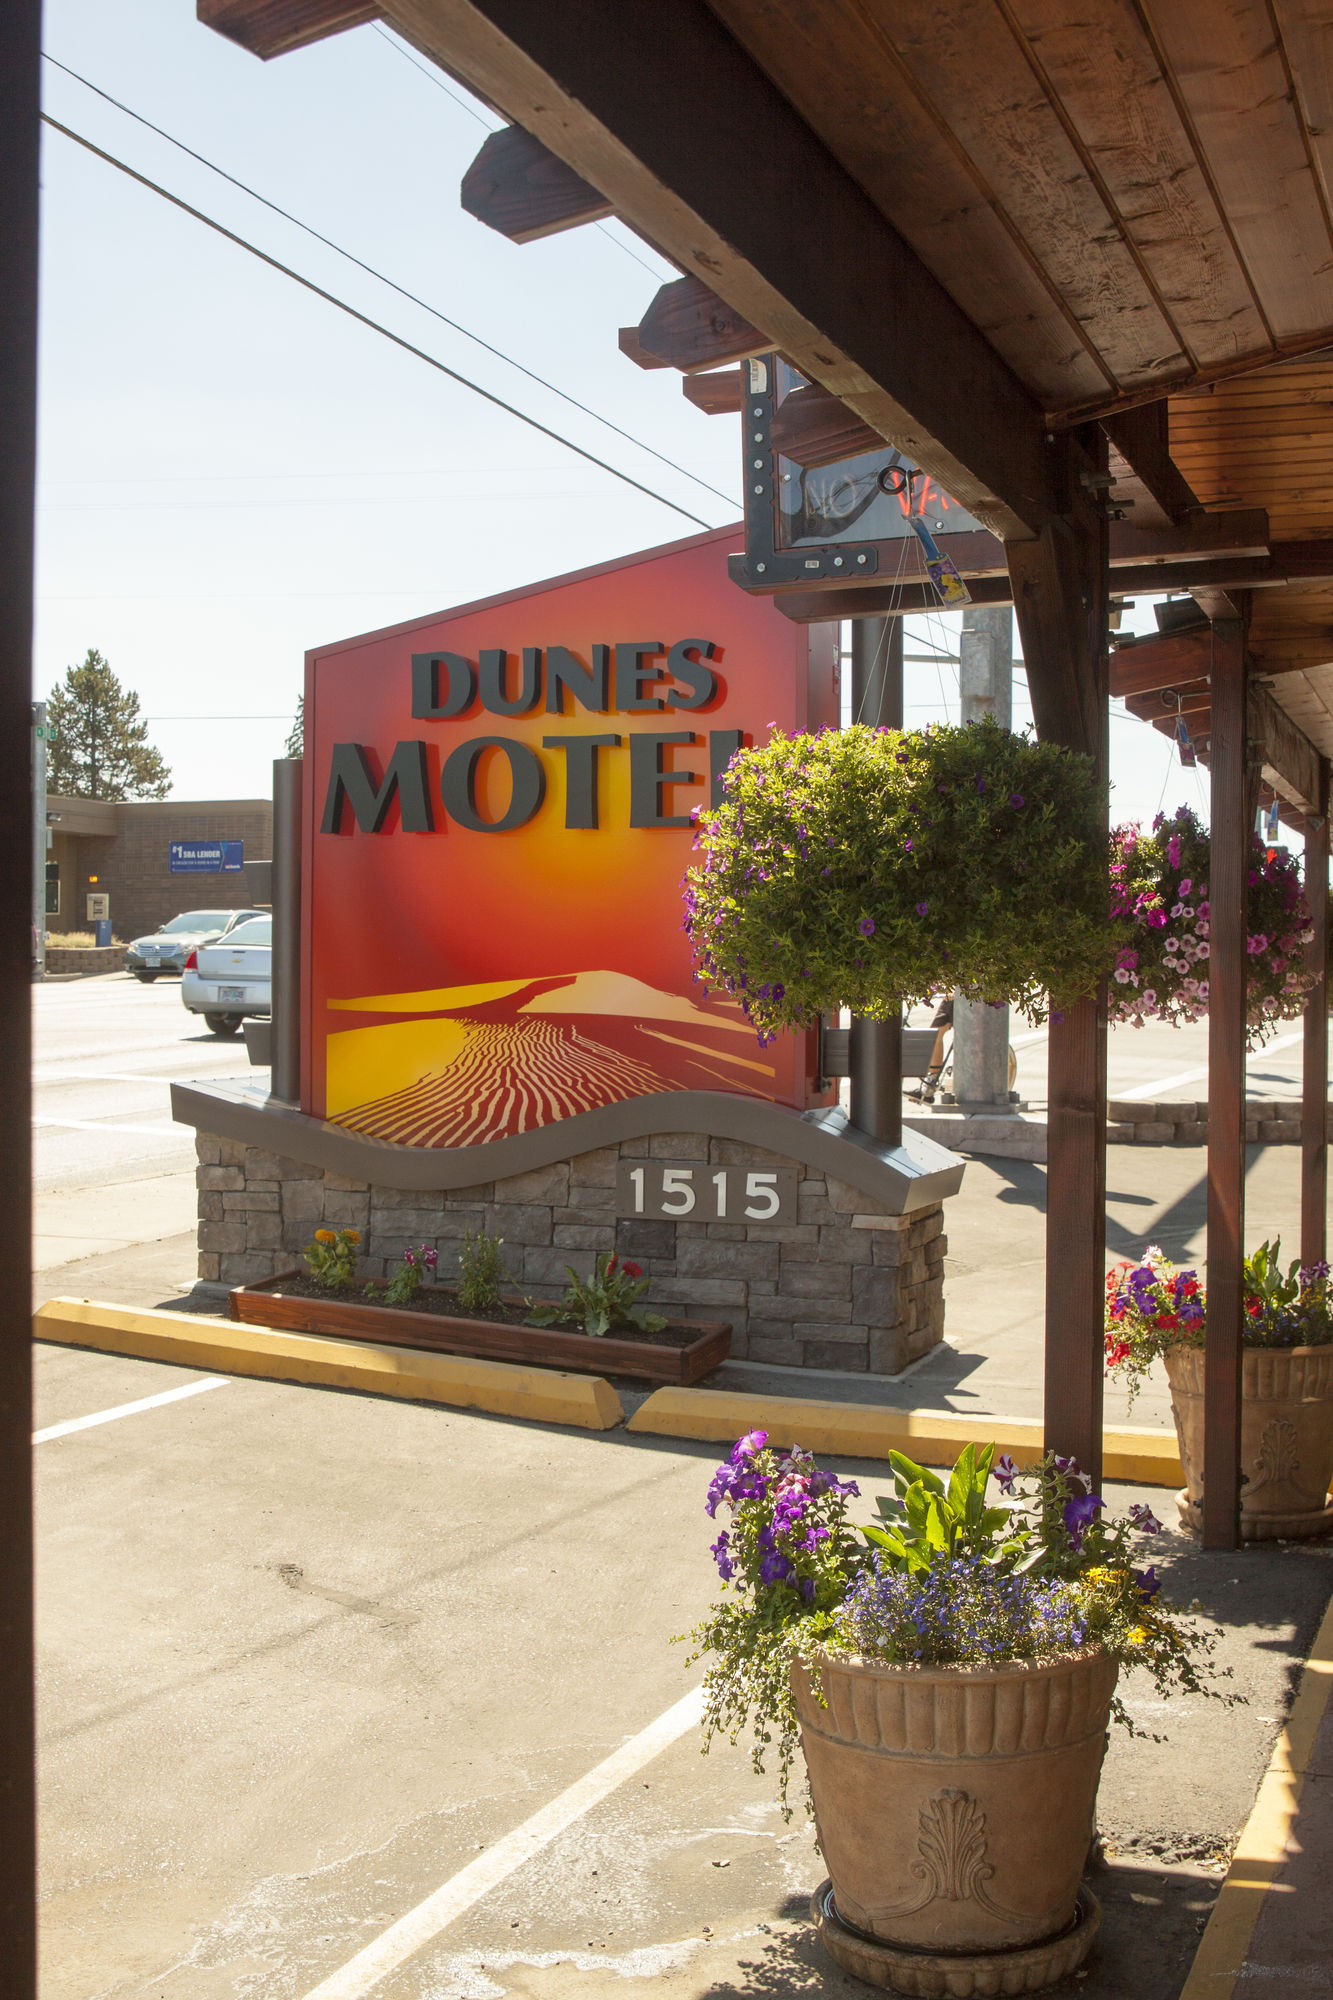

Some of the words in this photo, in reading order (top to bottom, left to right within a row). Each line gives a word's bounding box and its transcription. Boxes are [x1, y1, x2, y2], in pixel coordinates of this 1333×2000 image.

[804, 473, 857, 519] NO
[411, 638, 717, 719] DUNES
[630, 1167, 780, 1220] 1515
